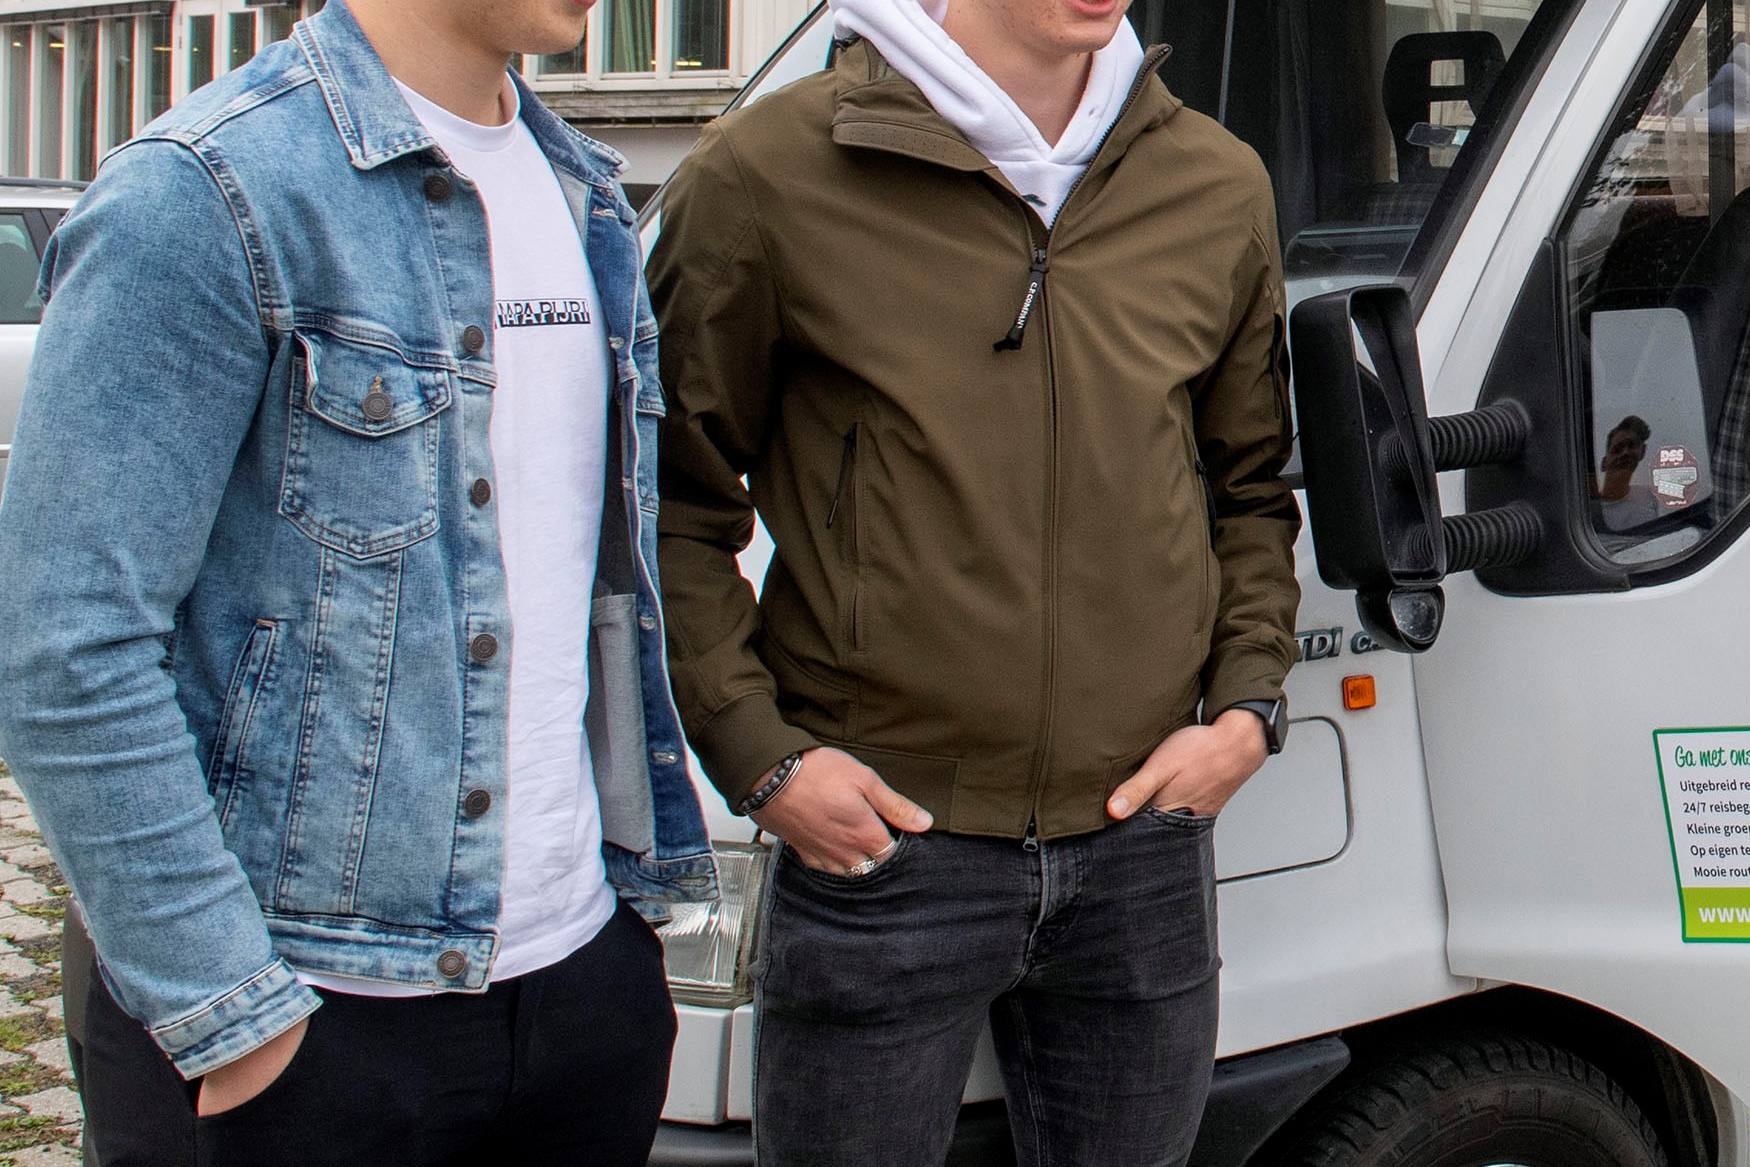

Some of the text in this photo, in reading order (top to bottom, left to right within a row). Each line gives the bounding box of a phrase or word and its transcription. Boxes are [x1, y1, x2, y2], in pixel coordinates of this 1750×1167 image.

[1674, 745, 1696, 768] Ga
[1700, 746, 1727, 767] met
[1679, 779, 1737, 794] Uitgebreid
[1683, 801, 1706, 815] 24/7
[1686, 823, 1721, 835] Kleine
[1690, 845, 1706, 858] Op
[1709, 844, 1738, 858] eigen
[1694, 866, 1727, 877] Mooie
